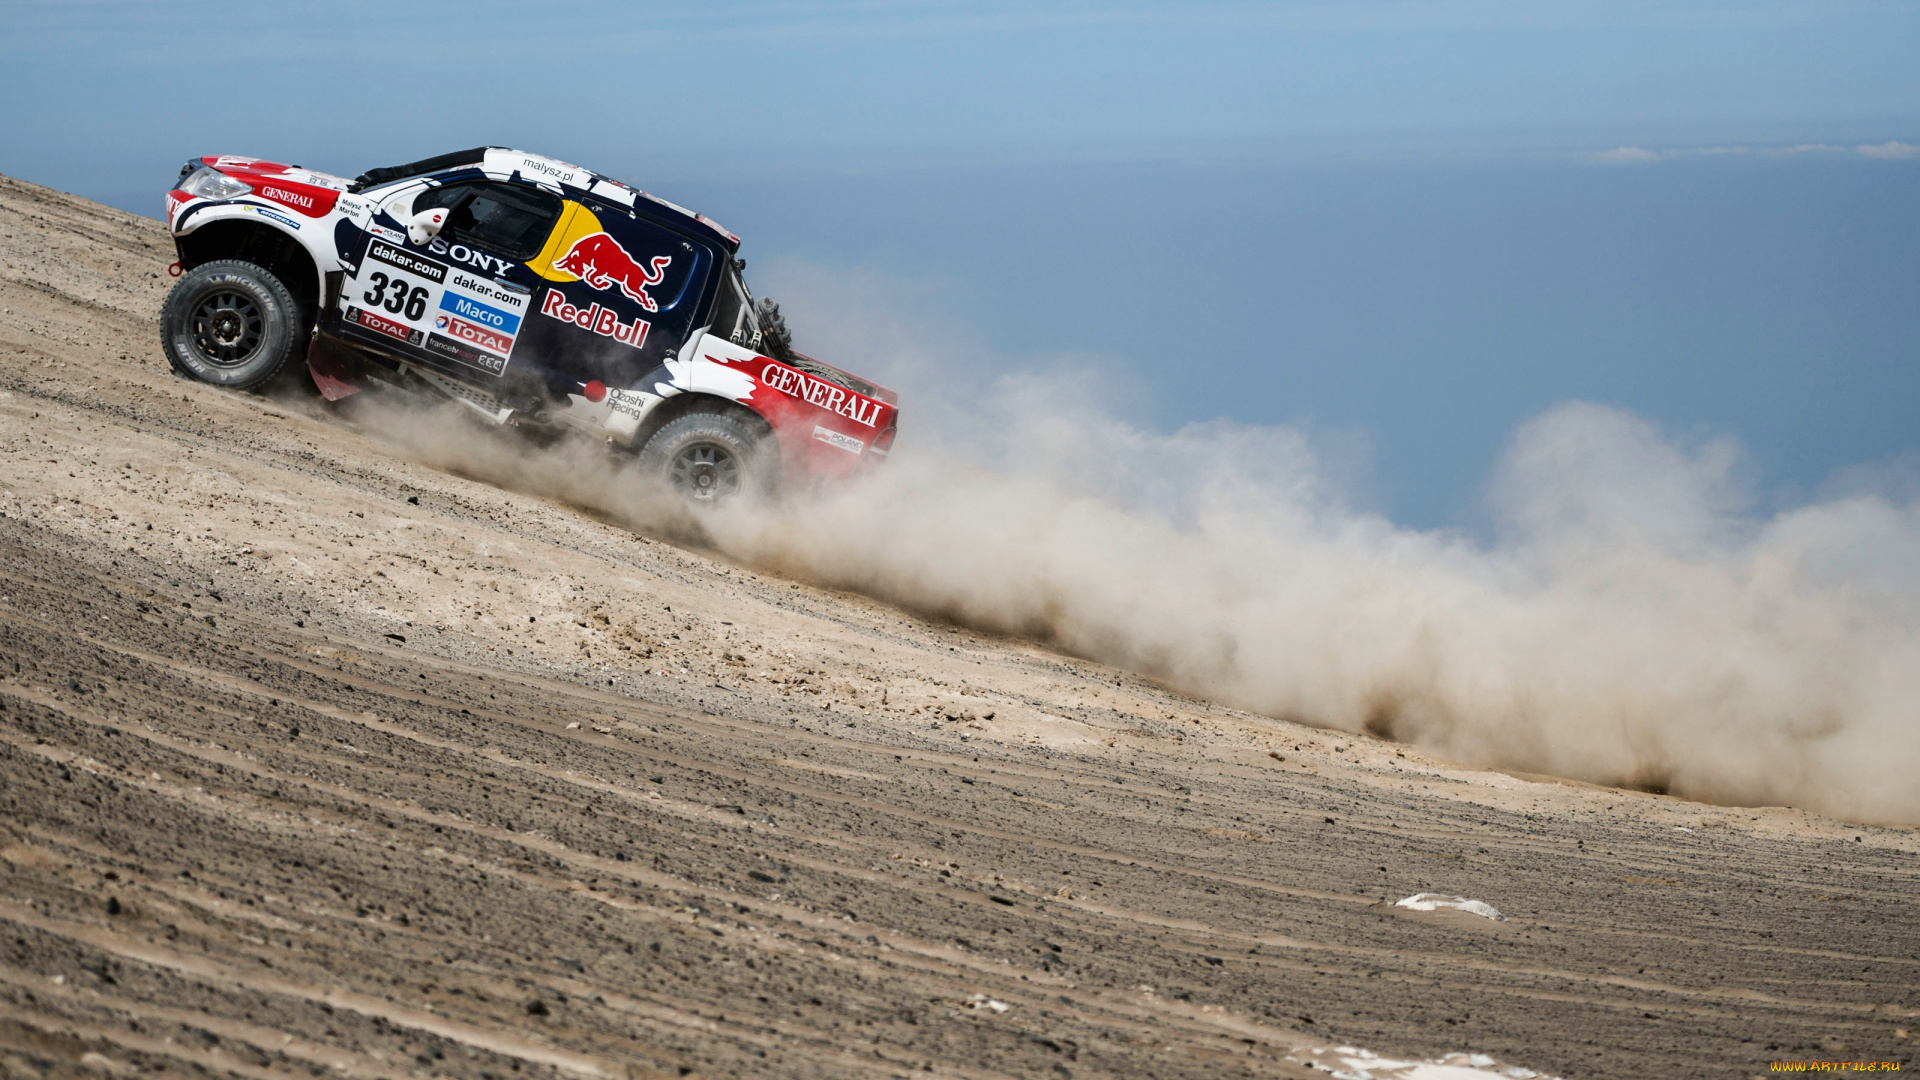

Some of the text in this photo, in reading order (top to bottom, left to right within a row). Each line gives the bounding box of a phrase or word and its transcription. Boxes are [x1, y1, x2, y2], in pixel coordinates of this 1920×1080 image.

[523, 159, 574, 181] malysz.pl
[262, 186, 314, 208] GENERALI
[373, 245, 442, 279] dakar.com
[428, 236, 514, 277] SONY
[224, 274, 276, 313] MICHELIN
[363, 271, 429, 321] 336
[453, 275, 521, 307] dakar.com
[364, 313, 406, 338] TOTAL
[455, 299, 504, 326] Macro
[453, 320, 507, 352] TOTAL
[606, 398, 641, 420] Racing
[610, 387, 645, 408] Ozoshi
[761, 363, 883, 428] GENERALI
[832, 433, 863, 449] POLAND
